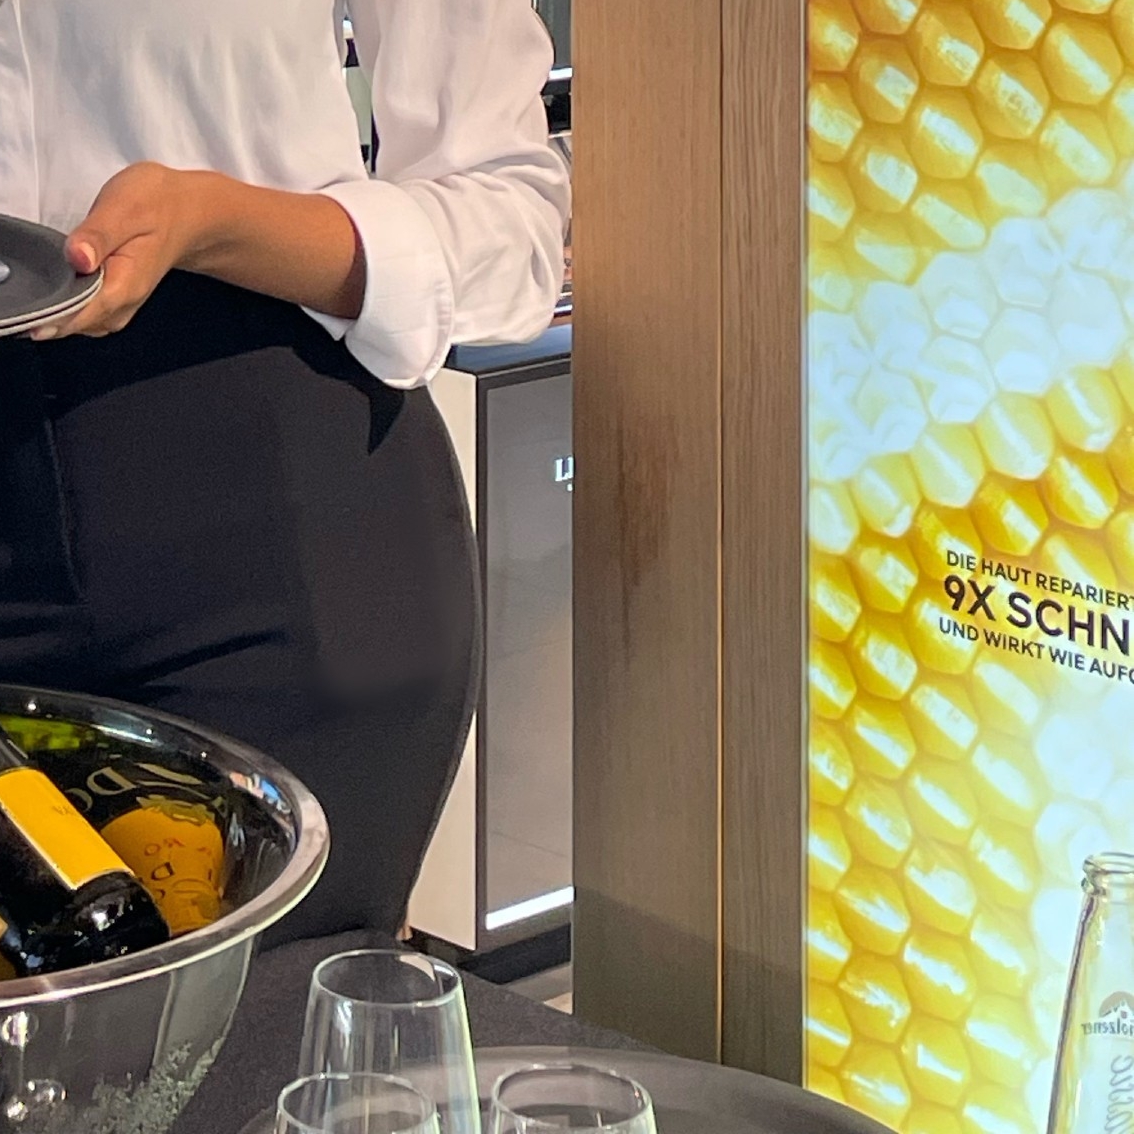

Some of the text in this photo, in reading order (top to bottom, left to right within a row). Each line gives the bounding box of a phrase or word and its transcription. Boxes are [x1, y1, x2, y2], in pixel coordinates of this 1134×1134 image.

[946, 549, 1134, 612] DIE HAUT REPARIER
[939, 616, 979, 642] UND
[982, 627, 1045, 660] WIRKT
[1048, 644, 1086, 671] WIE
[943, 573, 1130, 657] 9X SCHN
